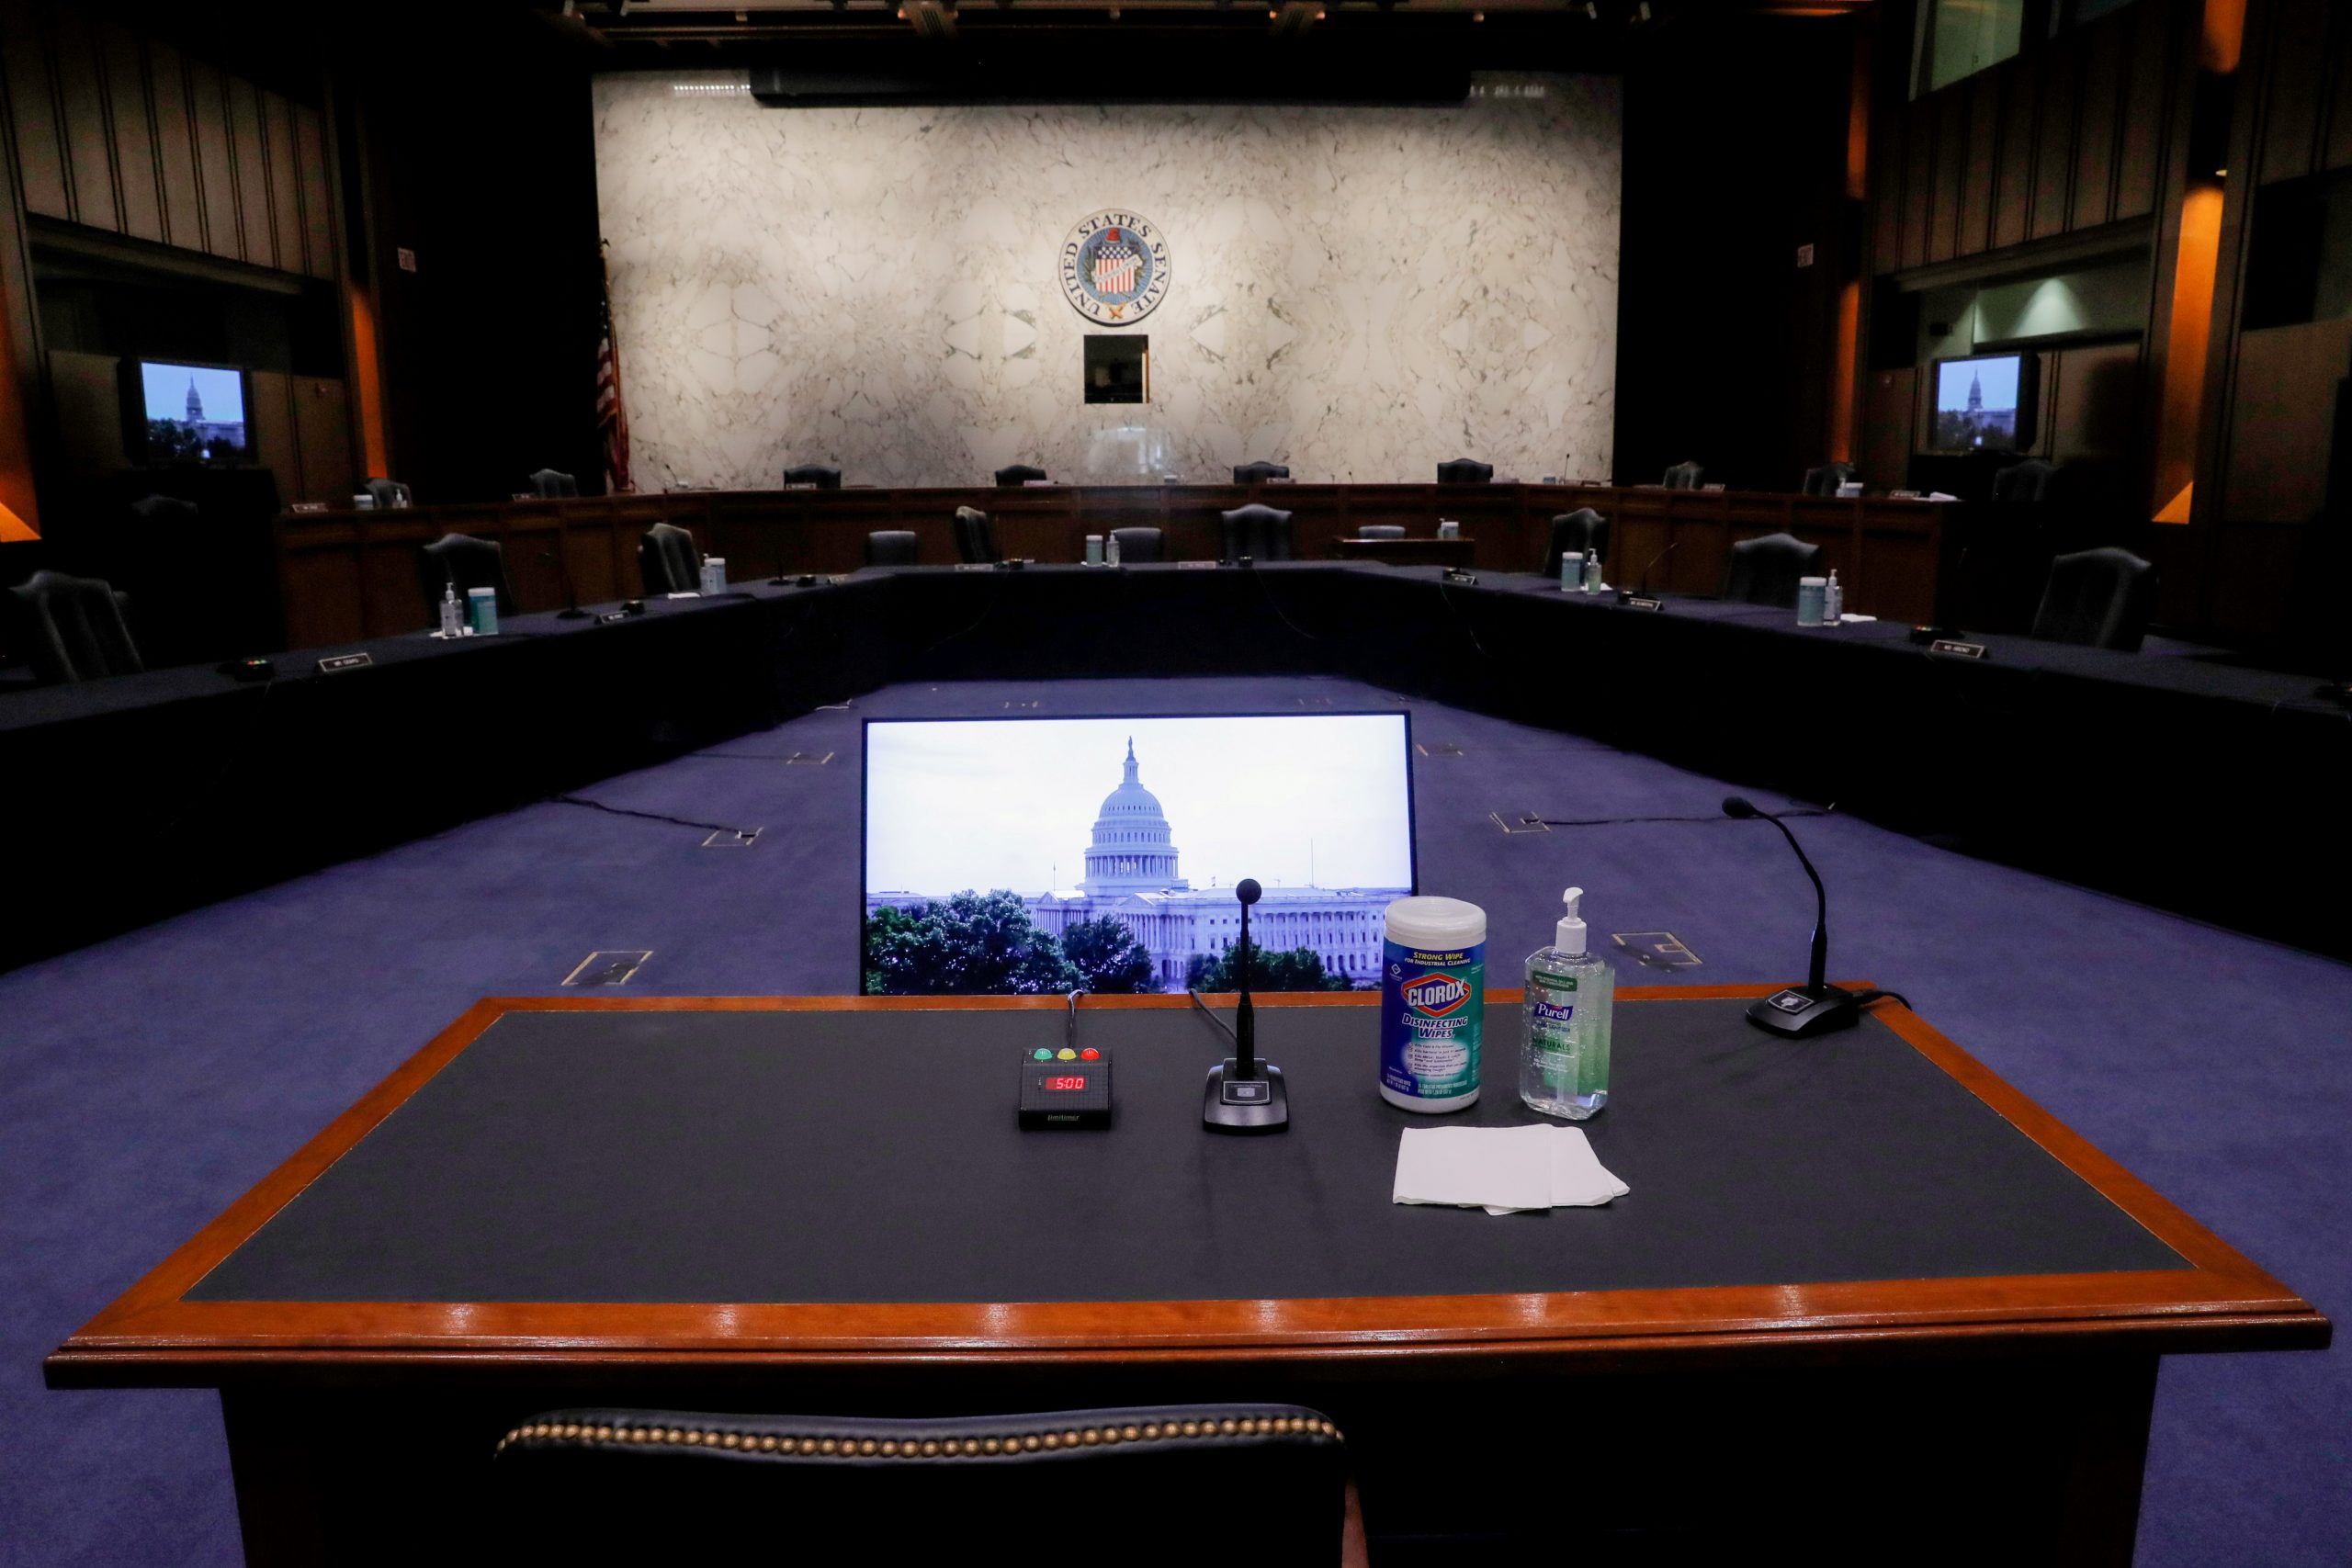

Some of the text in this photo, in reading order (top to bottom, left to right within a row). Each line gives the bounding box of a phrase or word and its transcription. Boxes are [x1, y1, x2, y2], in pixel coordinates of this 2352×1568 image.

[1063, 213, 1167, 316] UNITED STATES SENATE
[1413, 952, 1464, 961] STRONG WIPE
[1447, 958, 1471, 966] CLEANING
[1408, 978, 1465, 1007] CLOROX
[1538, 1003, 1569, 1020] Purell
[1402, 1013, 1468, 1028] DISINFECTING
[1419, 1027, 1453, 1038] WIPES
